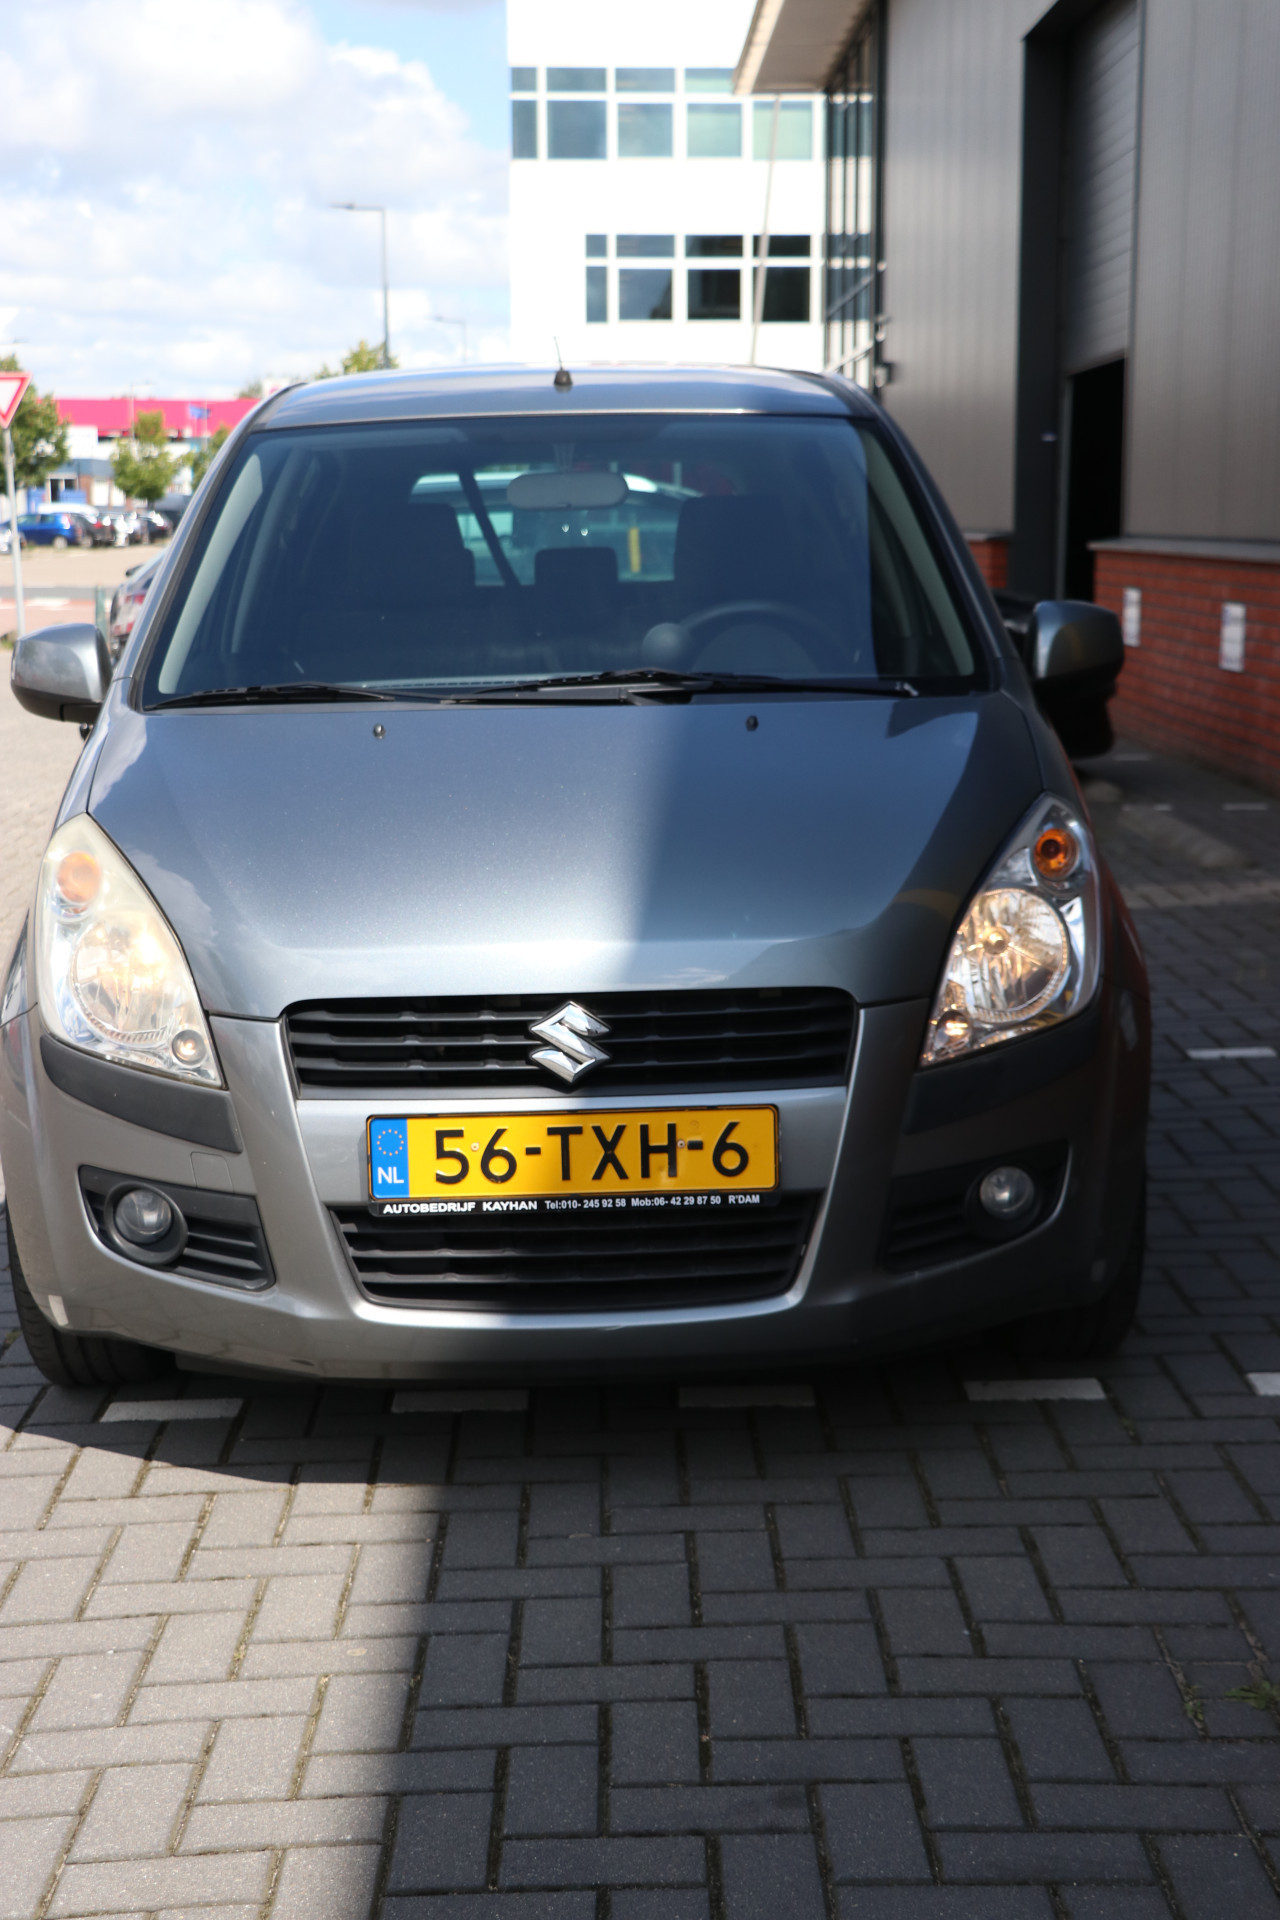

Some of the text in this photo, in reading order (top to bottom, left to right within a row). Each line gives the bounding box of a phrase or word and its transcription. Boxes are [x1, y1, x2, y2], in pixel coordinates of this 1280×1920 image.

[377, 1166, 405, 1184] NL
[383, 1202, 476, 1214] AUTOBEDRIJF
[482, 1201, 538, 1212] KAYHAN
[583, 1199, 600, 1209] 245
[602, 1199, 613, 1208] 92
[615, 1198, 627, 1207] 58
[631, 1197, 669, 1207] Mob:06-
[670, 1197, 682, 1206] 42
[684, 1197, 695, 1206] 29
[697, 1196, 708, 1205] 87
[710, 1196, 721, 1205] 50
[728, 1194, 760, 1204] R'DAM
